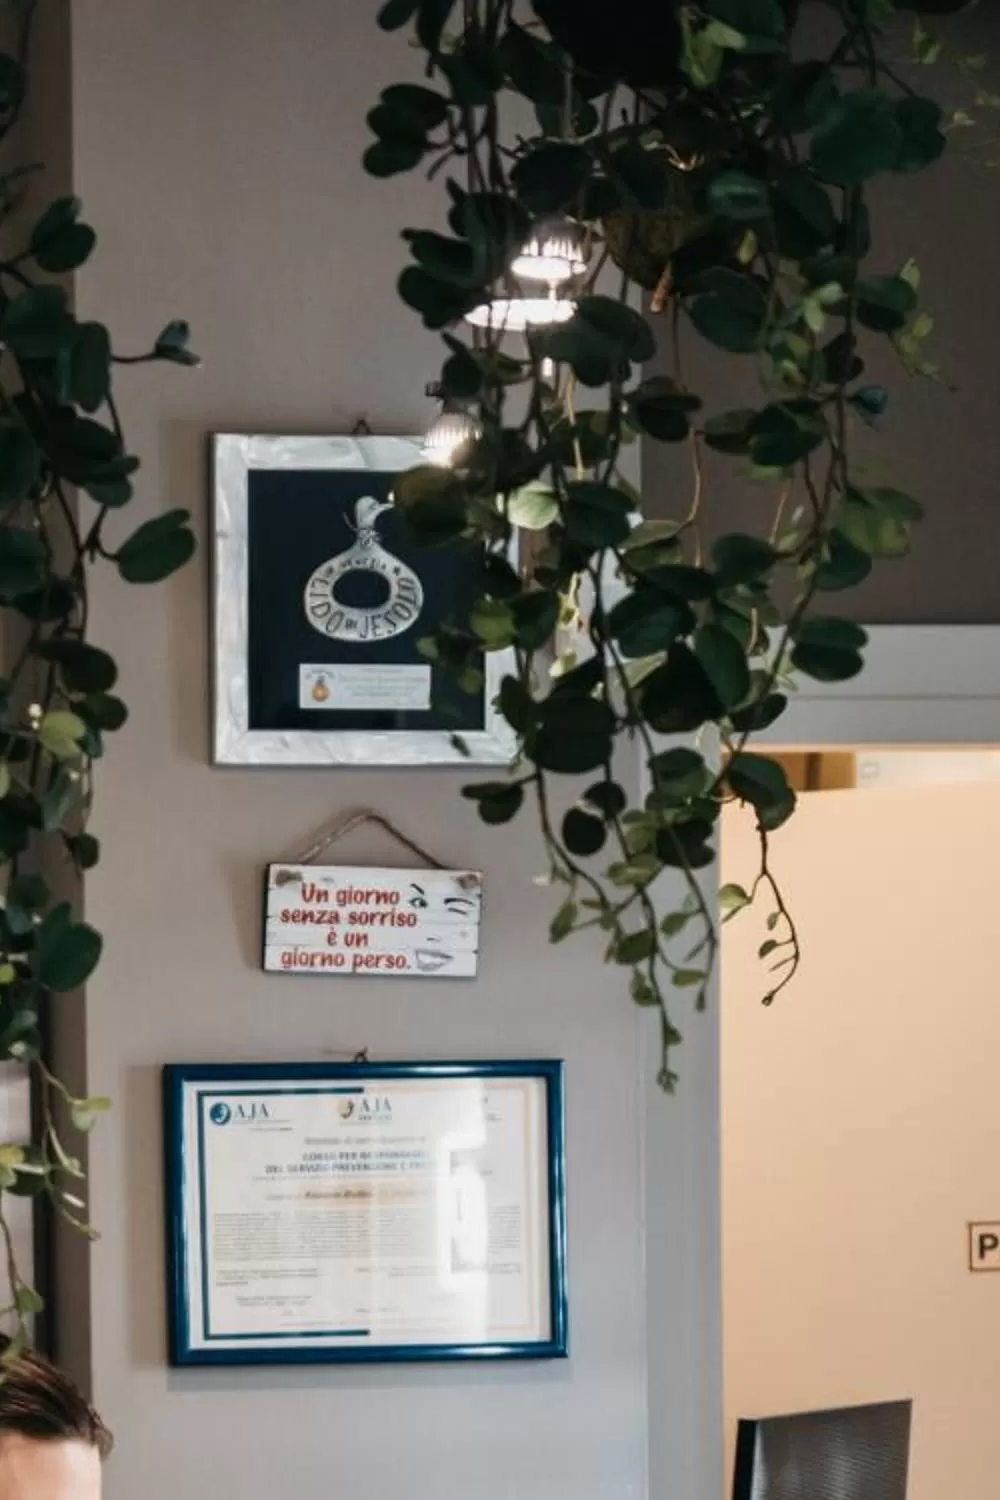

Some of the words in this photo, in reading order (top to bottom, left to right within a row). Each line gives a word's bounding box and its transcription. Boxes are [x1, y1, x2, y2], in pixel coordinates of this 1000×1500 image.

[301, 882, 329, 903] Un
[336, 884, 402, 907] giorno
[280, 908, 341, 925] senza
[347, 908, 418, 928] sorriso
[326, 926, 337, 947] è
[344, 932, 370, 947] un
[281, 948, 345, 970] giorno
[352, 952, 412, 973] perso.
